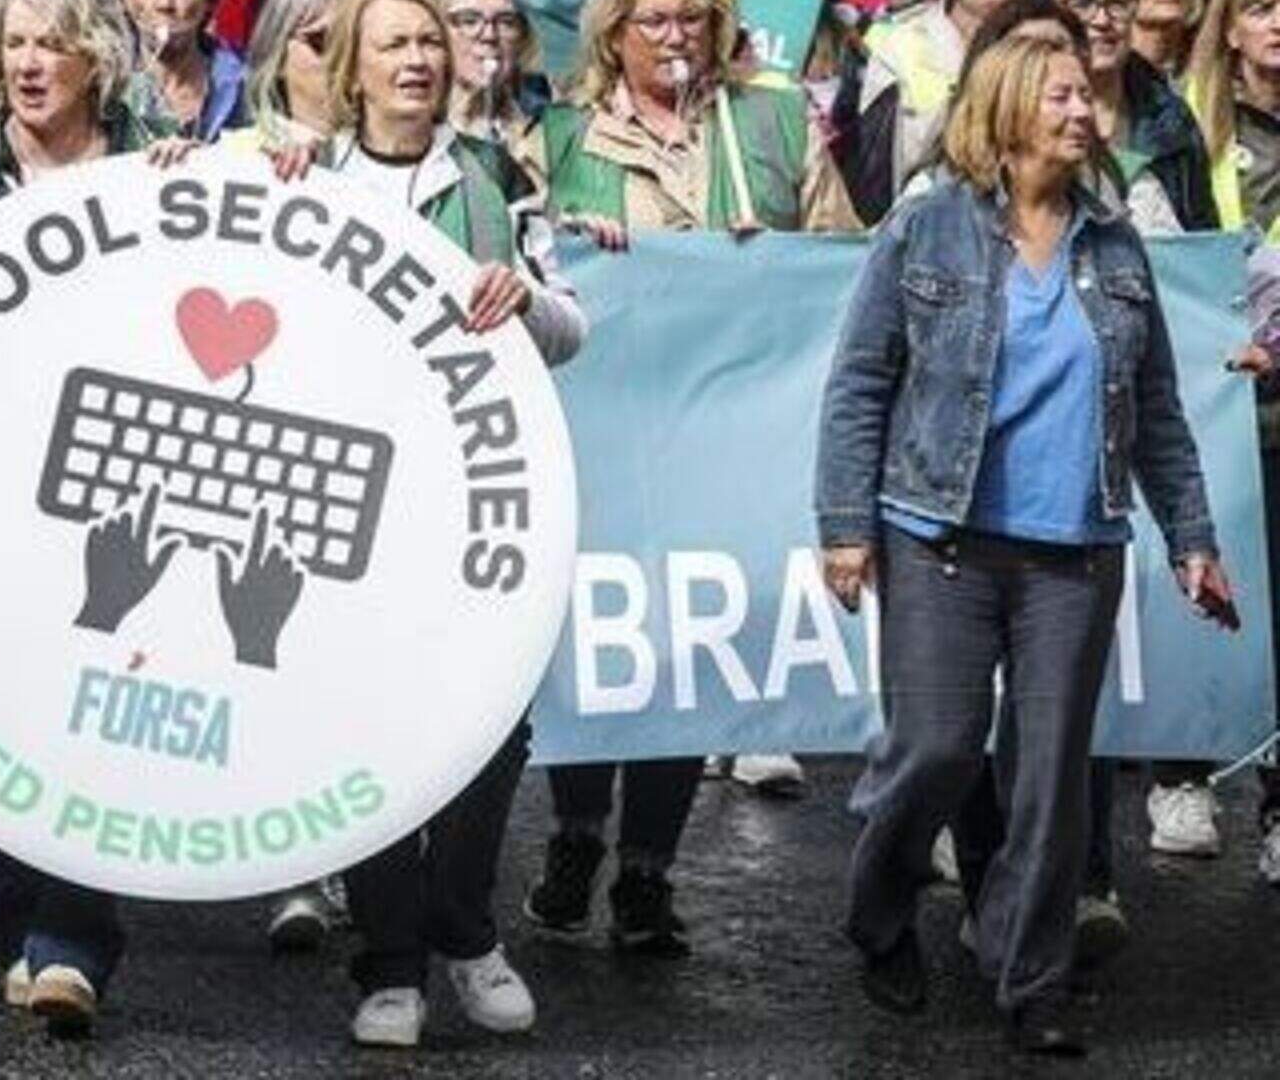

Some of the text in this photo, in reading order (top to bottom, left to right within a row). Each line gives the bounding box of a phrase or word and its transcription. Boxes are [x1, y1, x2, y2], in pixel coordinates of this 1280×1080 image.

[158, 179, 531, 594] SECRETARIES
[68, 650, 234, 769] FÓRSA
[54, 767, 389, 868] PENSIONS
